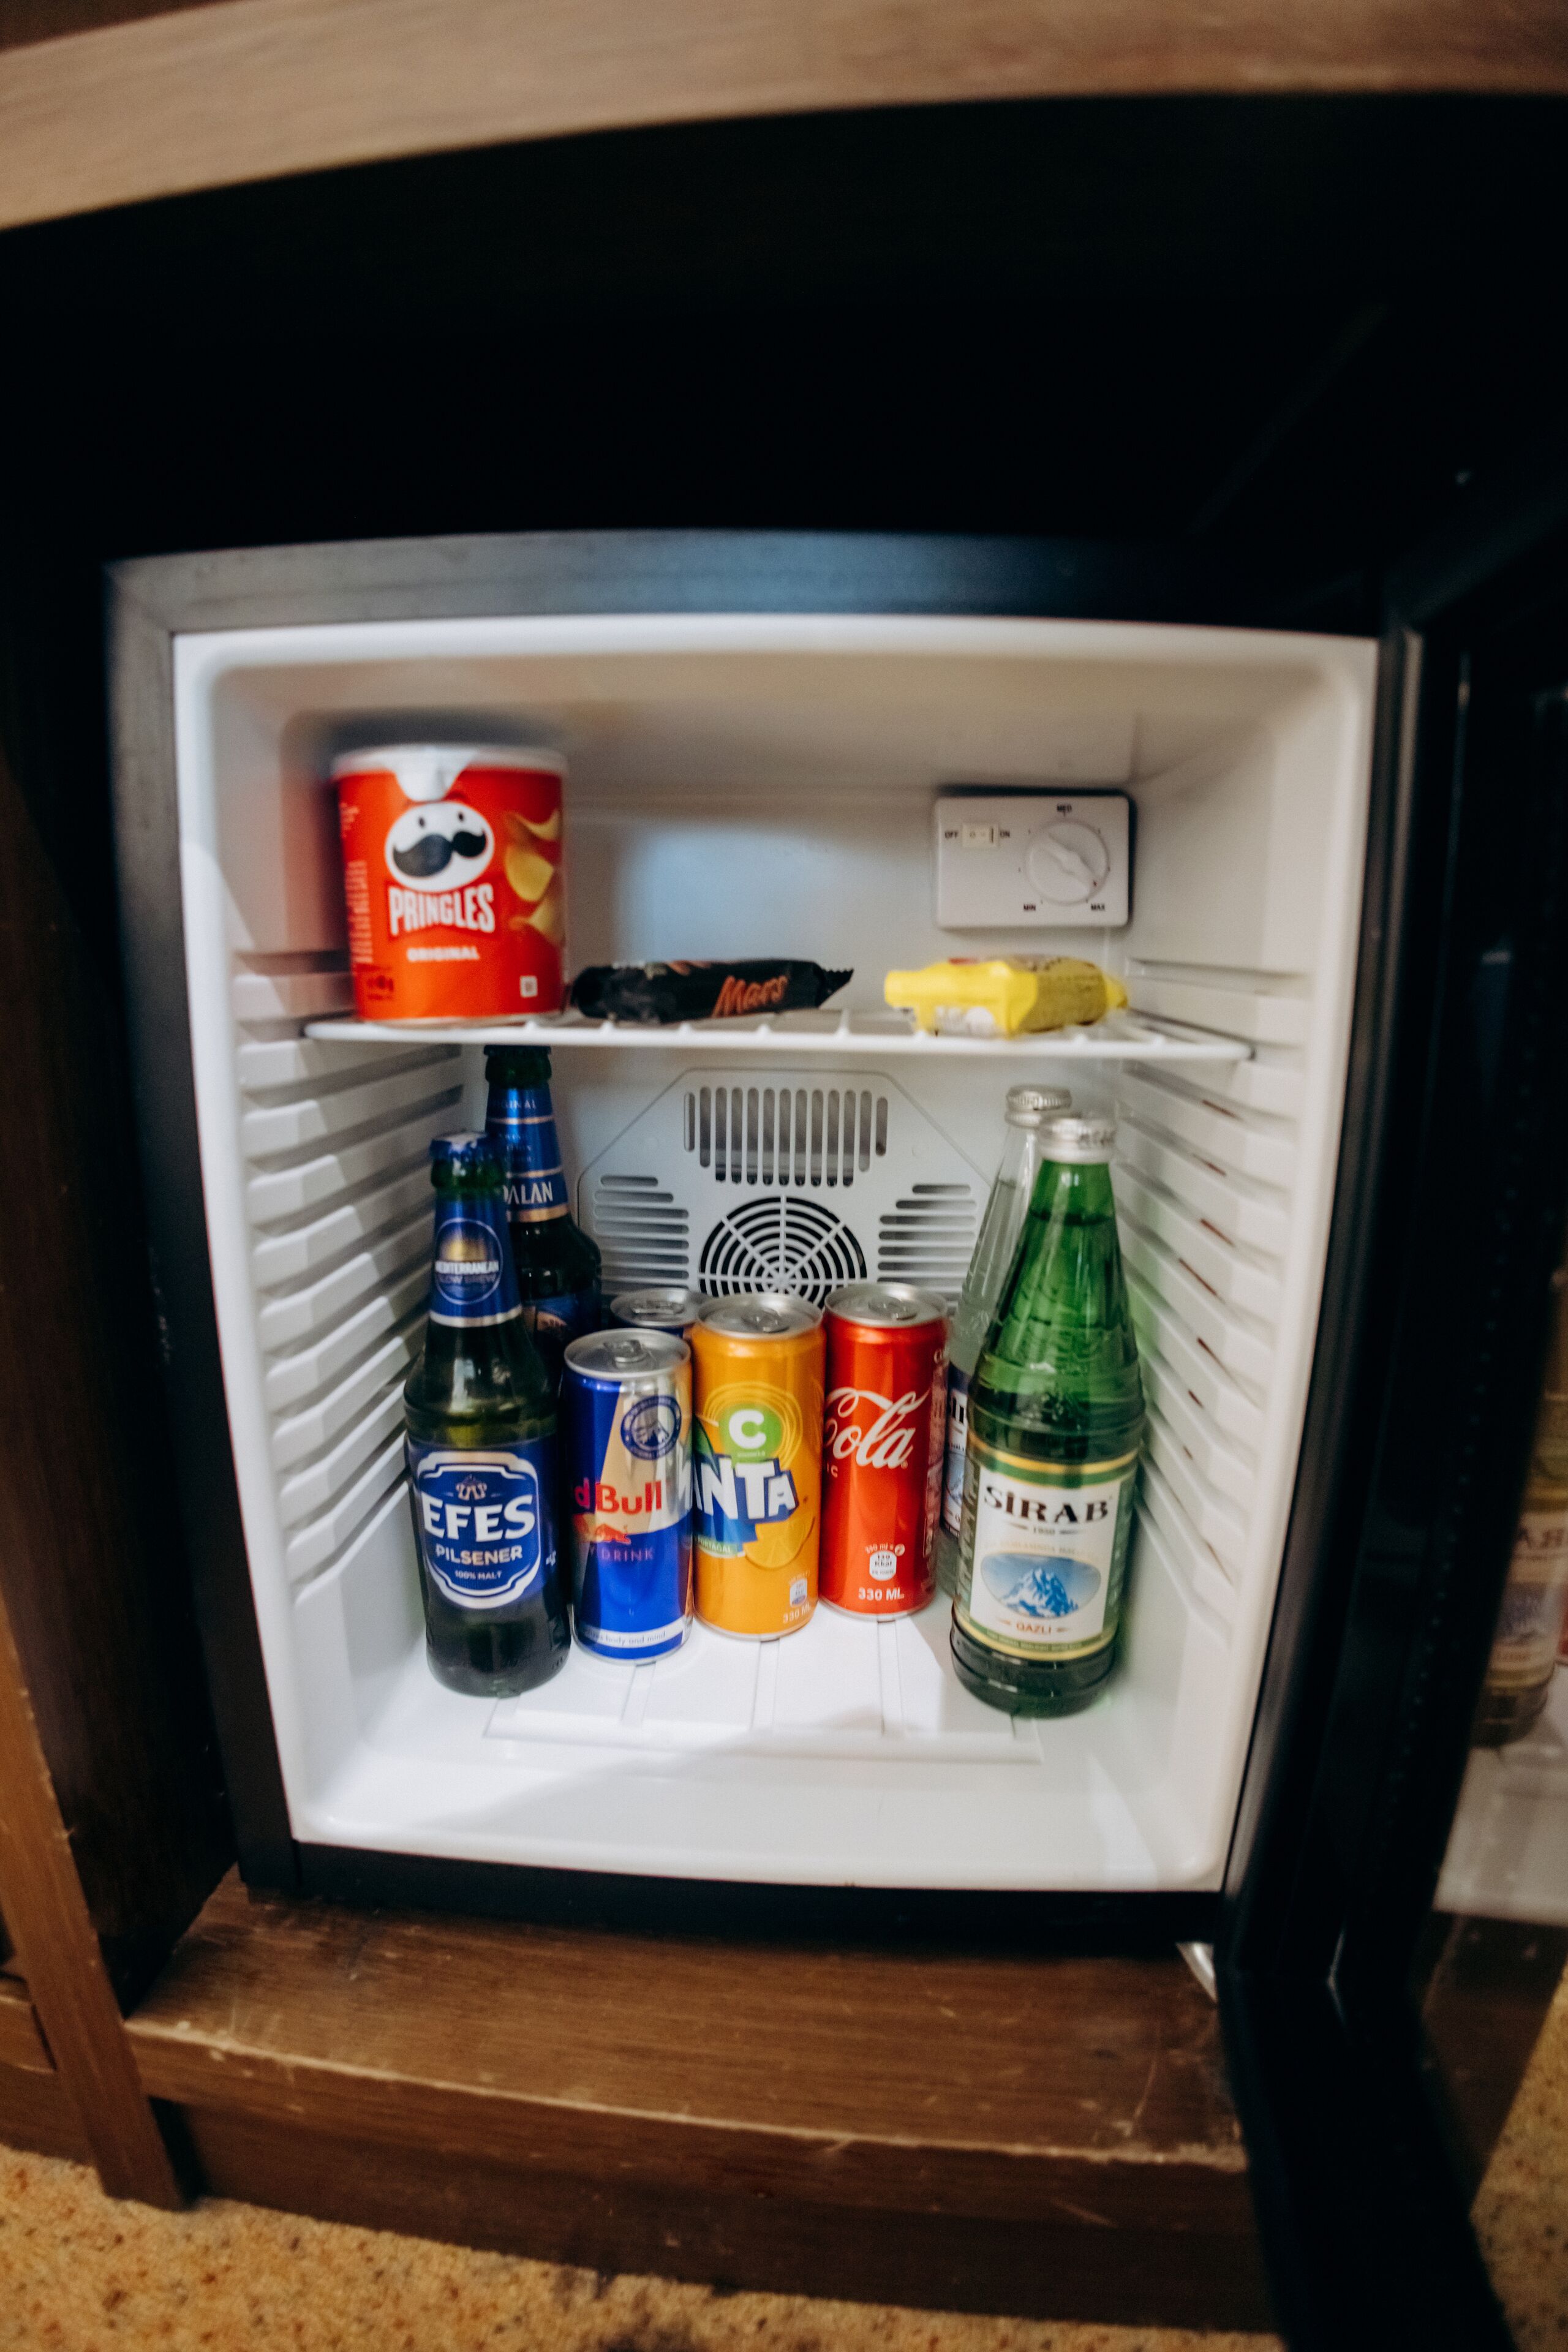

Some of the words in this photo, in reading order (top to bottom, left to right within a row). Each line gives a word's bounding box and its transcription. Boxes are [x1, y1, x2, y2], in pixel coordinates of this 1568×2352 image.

[944, 831, 959, 839] OFF
[388, 883, 495, 936] PRINGLES
[407, 946, 480, 962] ORIGINAL
[710, 974, 788, 1019] Mars
[729, 1409, 767, 1449] C
[595, 1480, 662, 1515] Bull
[693, 1457, 797, 1520] NTA
[421, 1491, 535, 1542] EFES
[435, 1543, 522, 1566] PILSENER
[601, 1547, 654, 1562] DRINK
[454, 1570, 477, 1580] 100%
[478, 1570, 502, 1580] MALT
[858, 1587, 882, 1601] 330
[886, 1587, 905, 1600] ML
[783, 1608, 800, 1624] 330
[647, 1630, 666, 1642] mind
